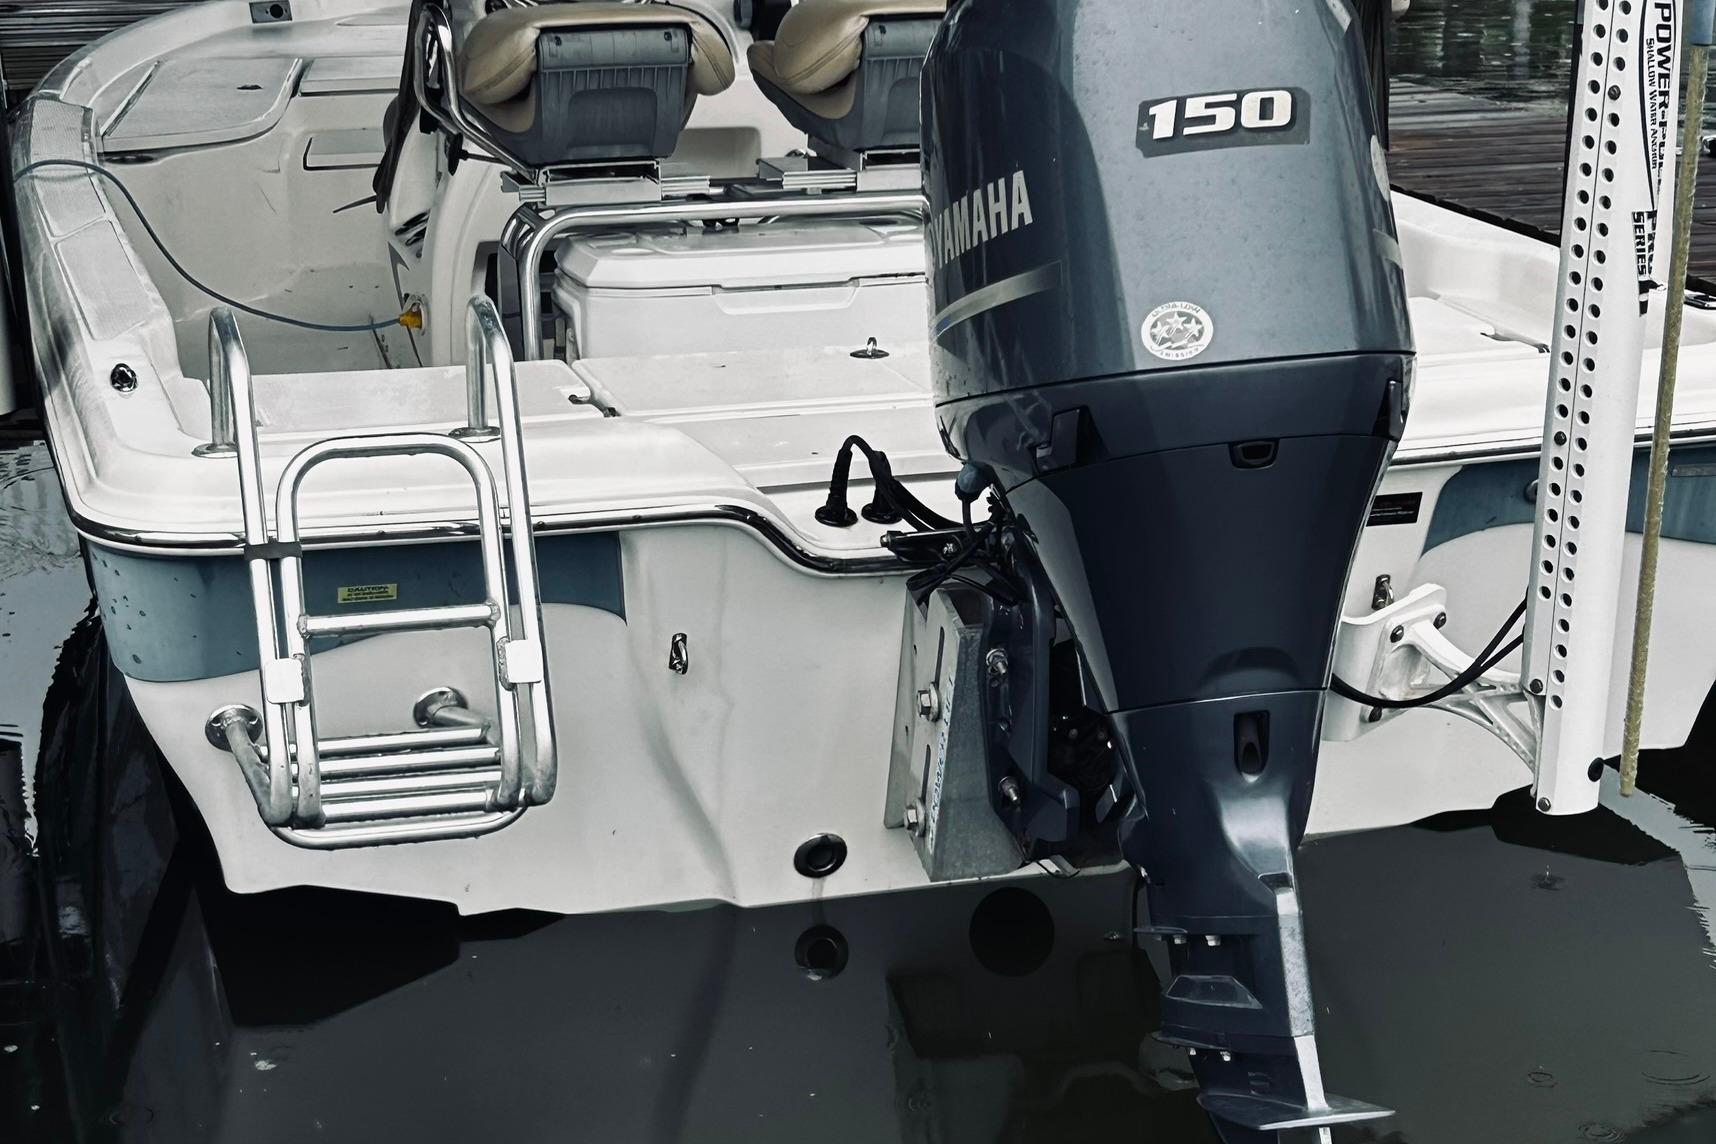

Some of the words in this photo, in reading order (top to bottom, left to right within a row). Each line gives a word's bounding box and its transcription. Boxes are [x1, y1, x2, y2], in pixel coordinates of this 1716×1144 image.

[1646, 37, 1656, 87] SHALLOW
[1149, 90, 1293, 140] 150
[1649, 89, 1658, 126] WATER
[934, 170, 1033, 270] YAMAHA
[1632, 211, 1647, 276] SERIES
